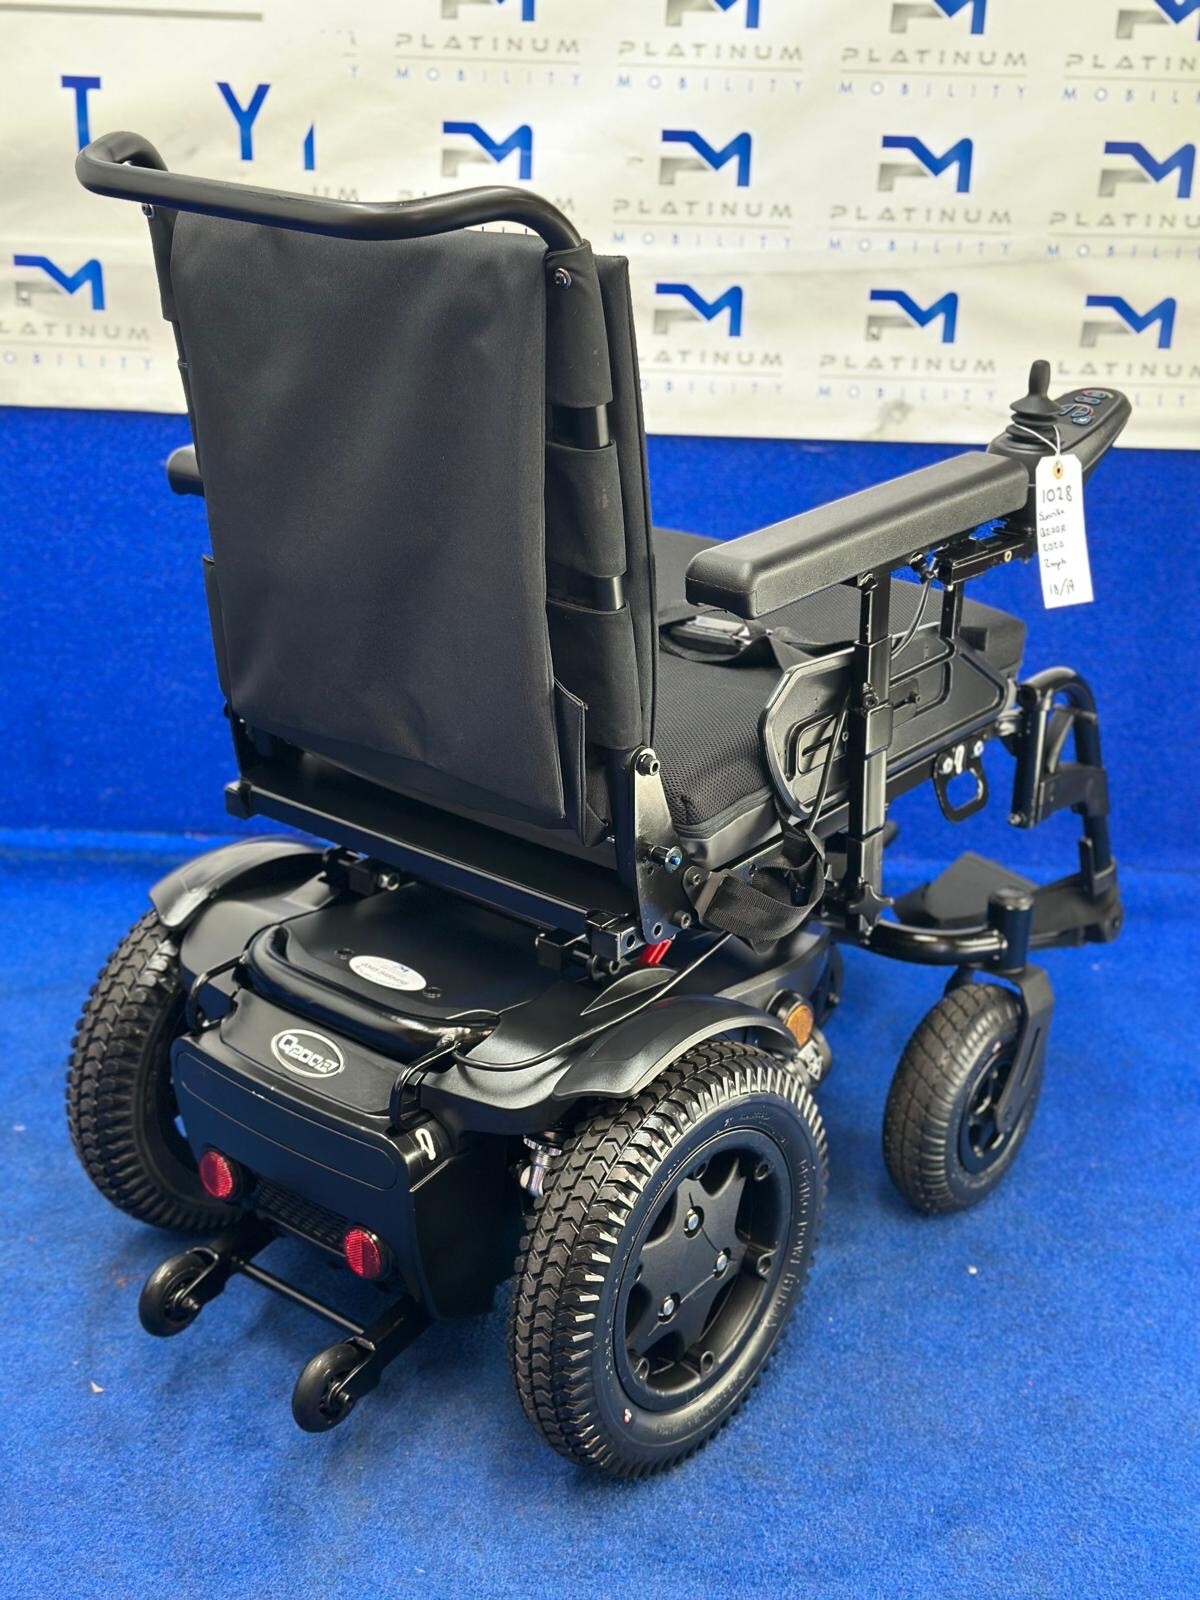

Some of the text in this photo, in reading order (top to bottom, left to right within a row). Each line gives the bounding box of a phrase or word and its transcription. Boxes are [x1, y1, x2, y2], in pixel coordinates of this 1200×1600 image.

[395, 33, 580, 53] PLATINUM
[618, 41, 803, 61] PLATINUM
[841, 48, 1027, 67] PLATINUM
[1065, 54, 1197, 71] PLATIN
[397, 67, 582, 86] MOBILITY
[618, 75, 802, 93] MOBILITY
[840, 82, 1025, 102] MOBILITY
[612, 199, 793, 218] PLATINUM
[829, 205, 1012, 223] PLATINUM
[613, 232, 791, 248] MOBILITY
[830, 239, 1011, 255] MOBILITY
[819, 355, 996, 372] PLATINUM
[818, 387, 995, 401] MOBILITY
[1042, 485, 1073, 504] 1028
